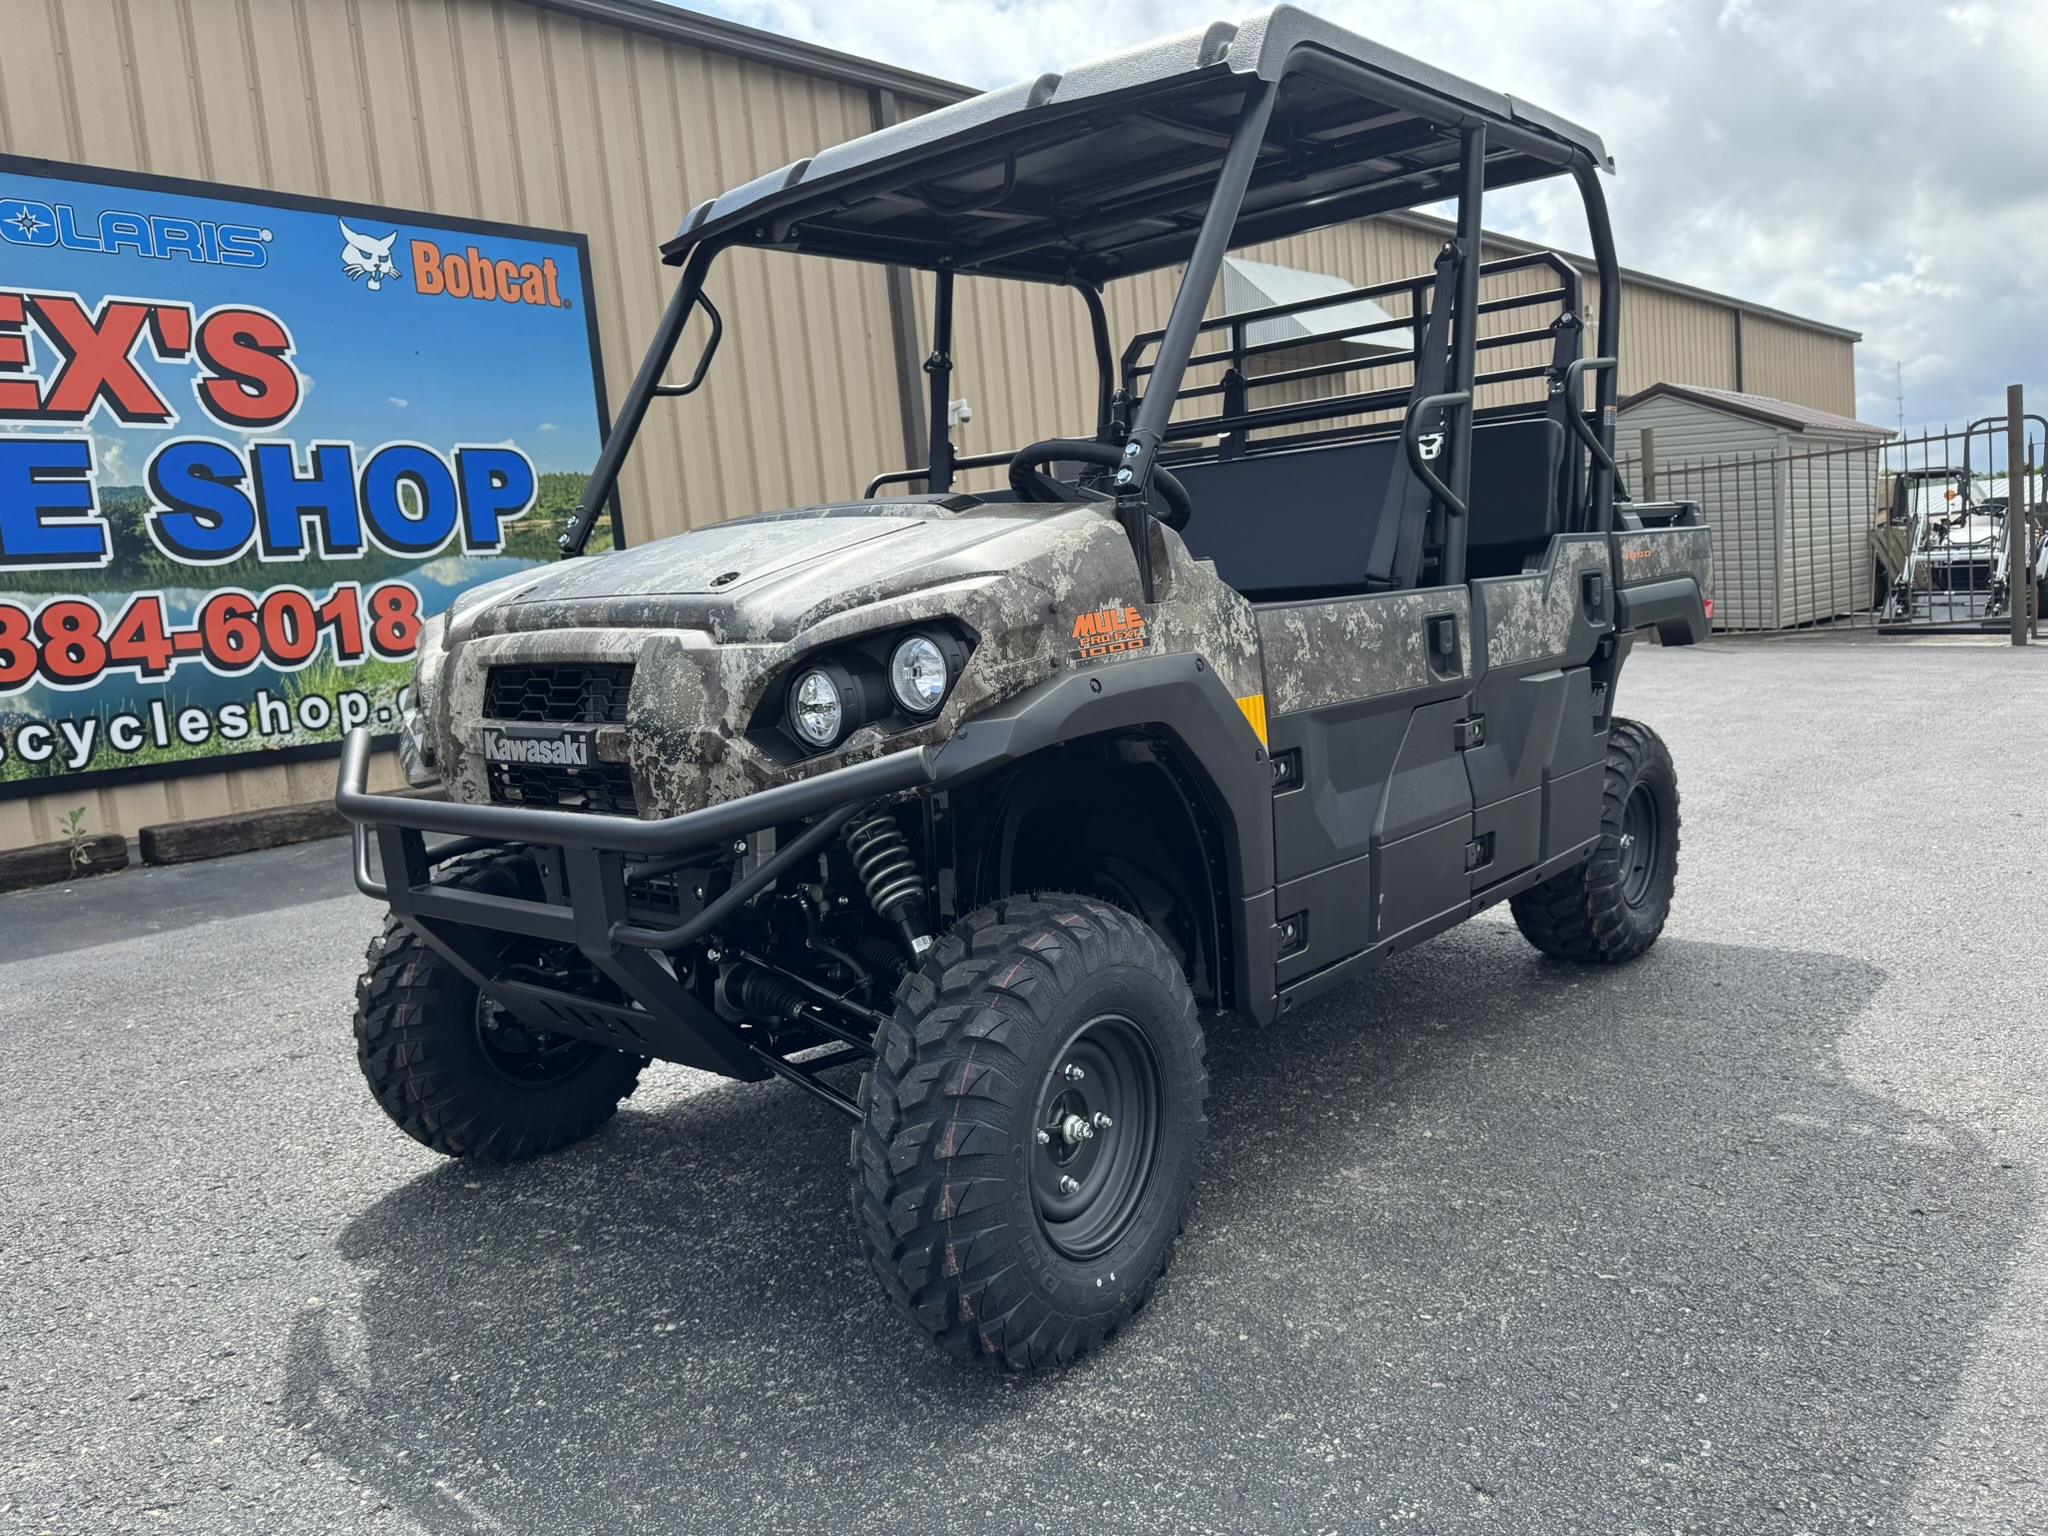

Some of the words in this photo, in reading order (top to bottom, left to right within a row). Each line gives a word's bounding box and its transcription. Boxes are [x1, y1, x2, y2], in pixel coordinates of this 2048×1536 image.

[411, 239, 562, 308] Bobcat
[0, 437, 107, 565] E
[149, 441, 534, 561] SHOP
[1072, 606, 1146, 638] MULE
[1080, 639, 1144, 658] 1000
[0, 687, 408, 769] cycleshop.
[484, 731, 588, 765] Kawasaki
